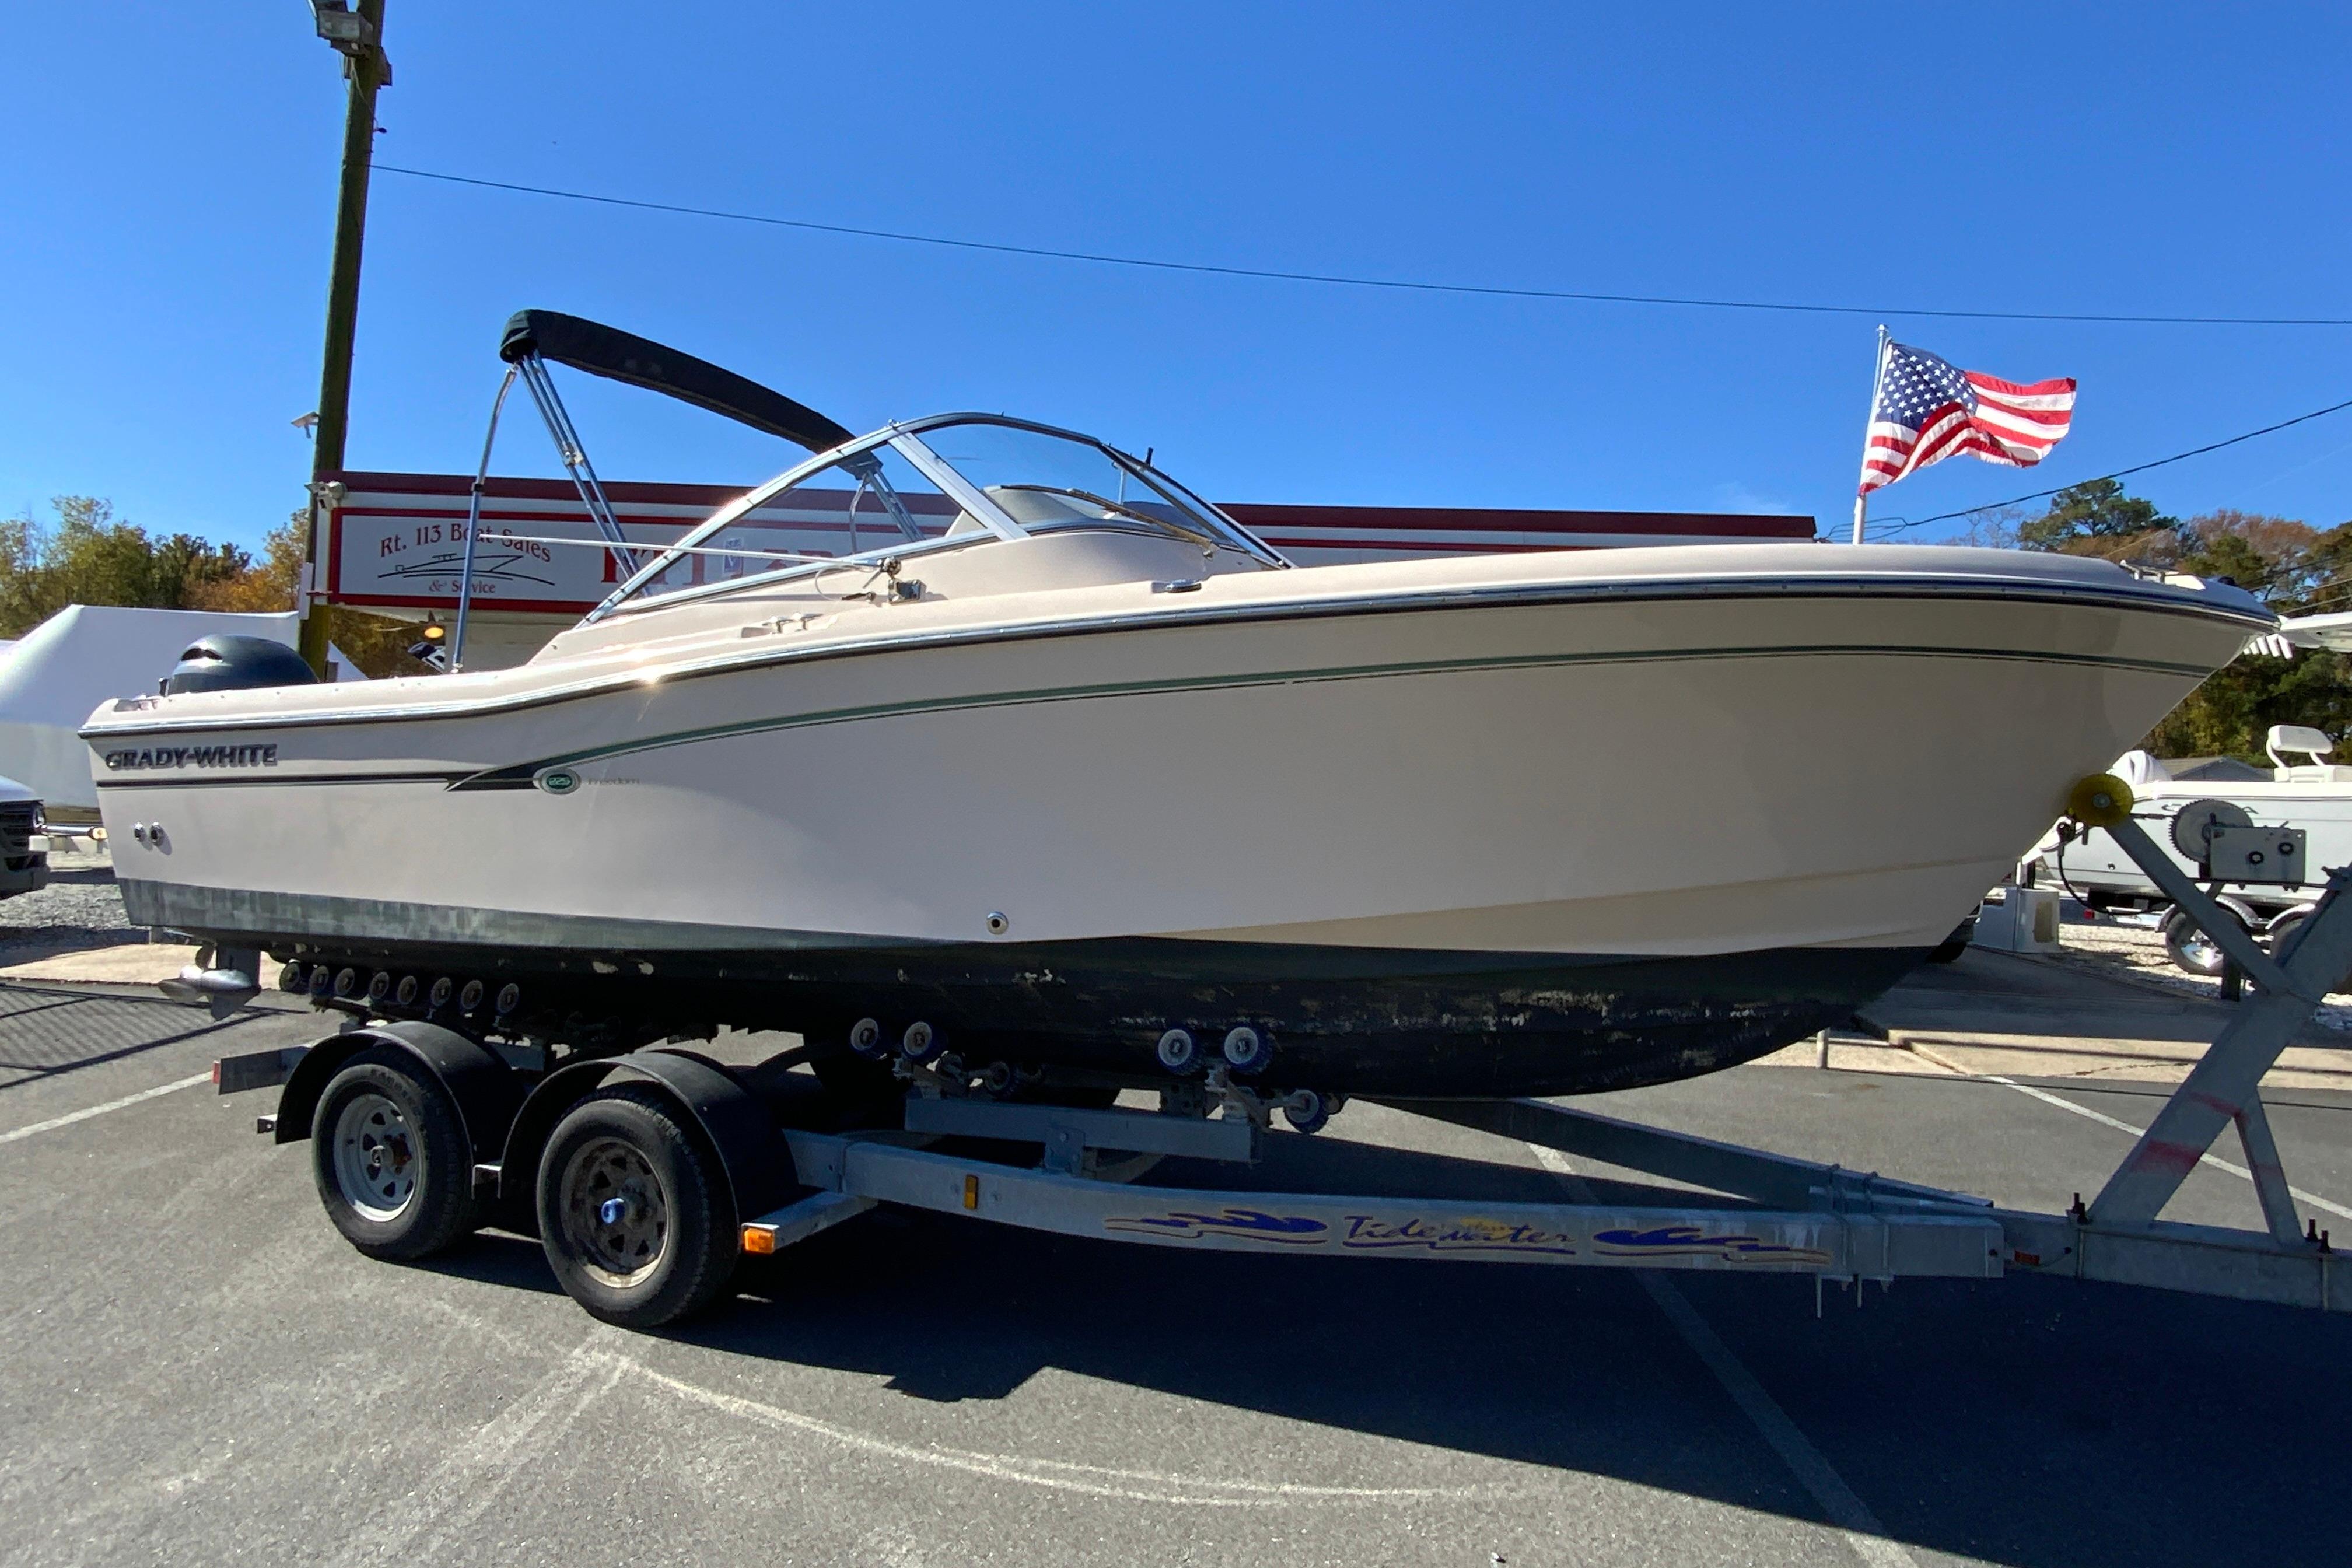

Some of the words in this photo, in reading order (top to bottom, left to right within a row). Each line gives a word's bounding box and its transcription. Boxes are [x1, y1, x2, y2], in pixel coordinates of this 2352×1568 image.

[381, 534, 407, 558] Rt.
[416, 525, 441, 546] 113
[502, 528, 551, 562] Sales
[452, 580, 495, 593] Svice
[106, 744, 277, 771] GRADY-WHITE
